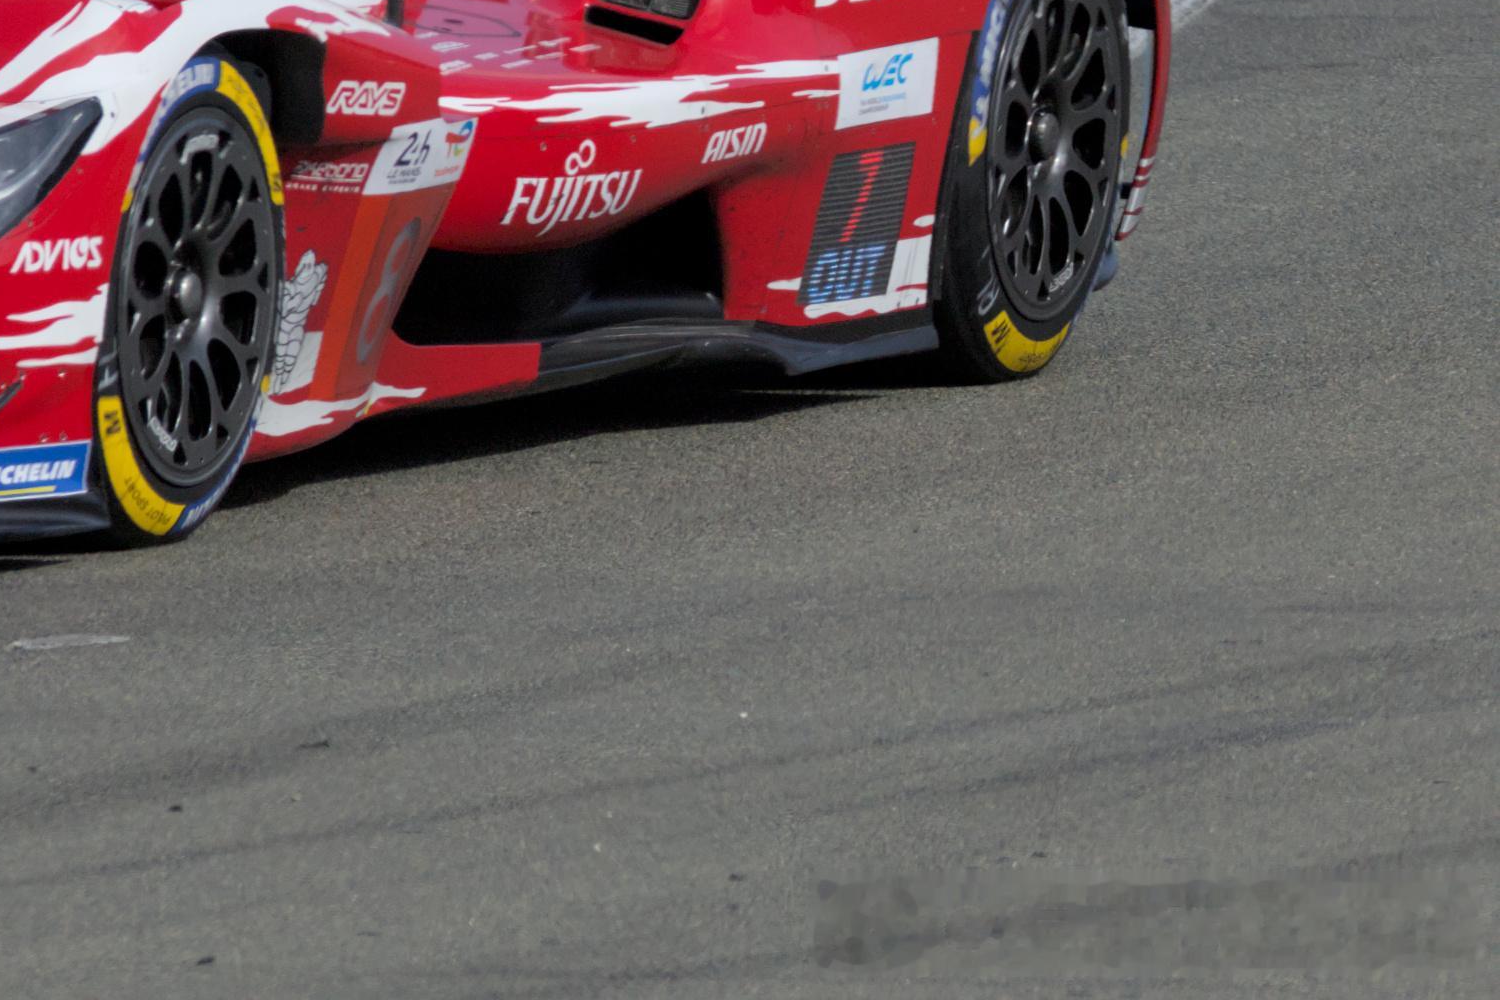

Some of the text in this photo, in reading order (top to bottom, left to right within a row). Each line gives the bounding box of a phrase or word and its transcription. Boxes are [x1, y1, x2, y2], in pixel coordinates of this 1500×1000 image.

[861, 52, 914, 92] WEC
[326, 80, 407, 116] RAYS
[701, 122, 768, 164] AISIN
[500, 168, 643, 238] FUJITSU
[806, 244, 887, 304] OUT
